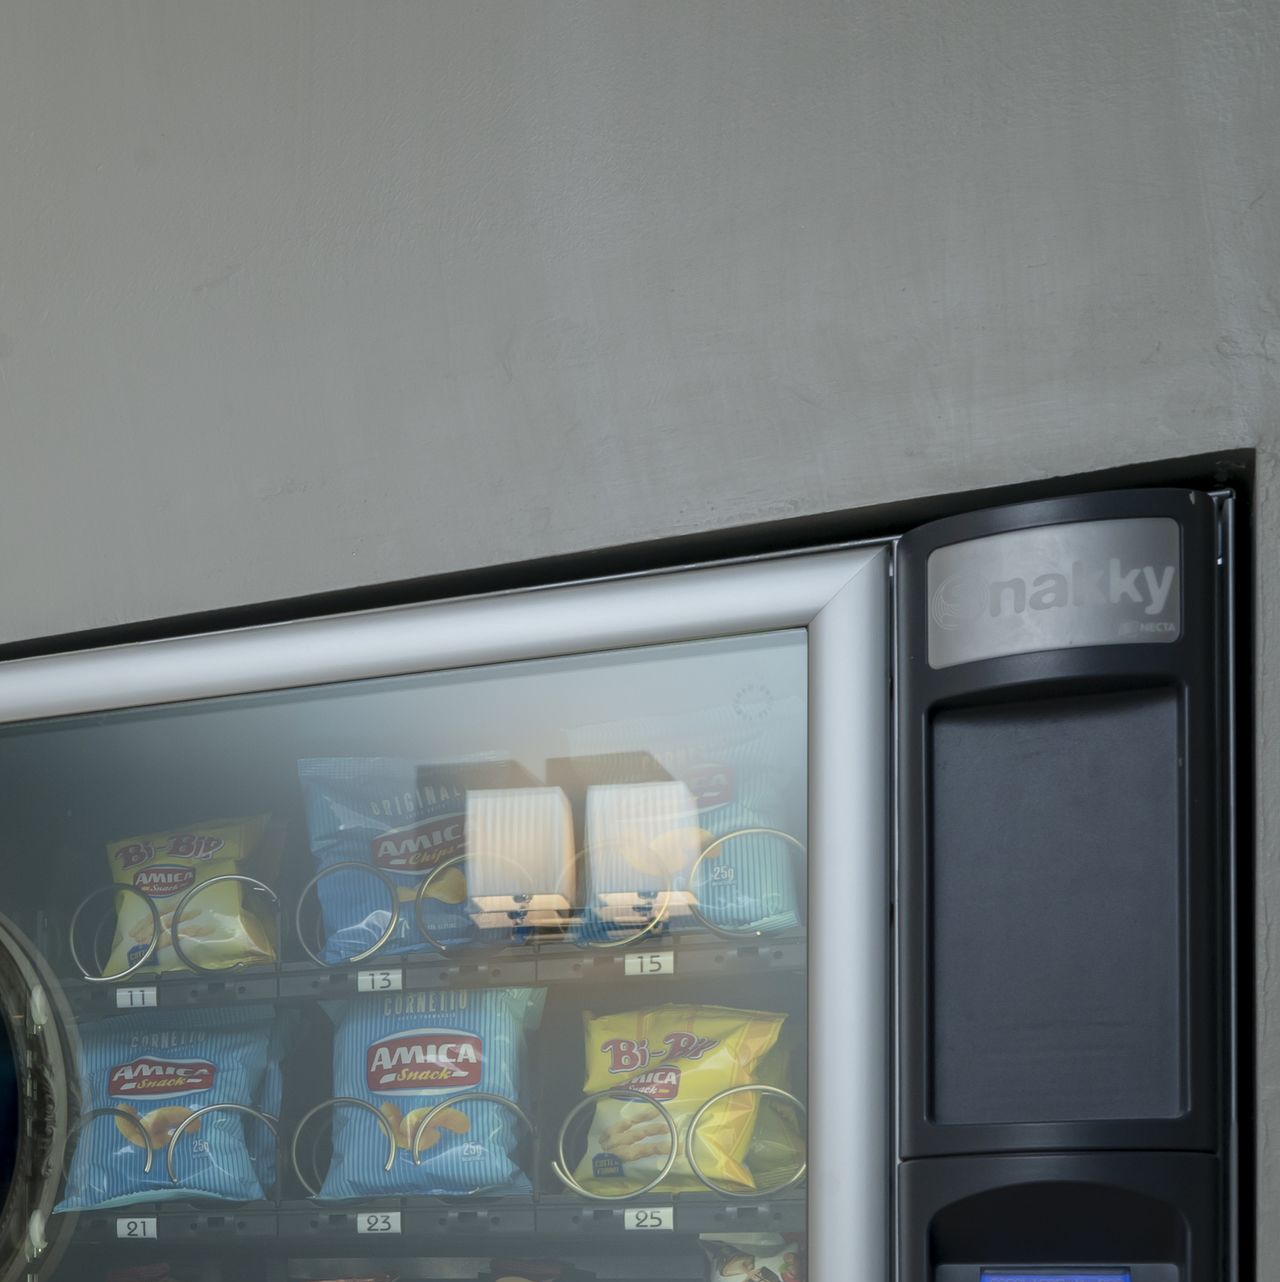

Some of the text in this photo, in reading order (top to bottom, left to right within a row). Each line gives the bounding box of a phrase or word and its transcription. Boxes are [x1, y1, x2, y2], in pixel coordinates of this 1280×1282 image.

[377, 823, 462, 858] AMIC
[135, 871, 193, 885] AMICA
[713, 865, 735, 880] 25g
[638, 956, 663, 974] 15
[369, 971, 392, 990] 13
[127, 990, 145, 1007] 11
[370, 1043, 477, 1072] AMICA
[112, 1063, 210, 1082] AMICA
[396, 1068, 452, 1082] Snack
[137, 1076, 186, 1089] Snack
[462, 1142, 482, 1157] 25g
[366, 1214, 392, 1232] 23
[635, 1211, 663, 1228] 25
[126, 1220, 147, 1237] 21
